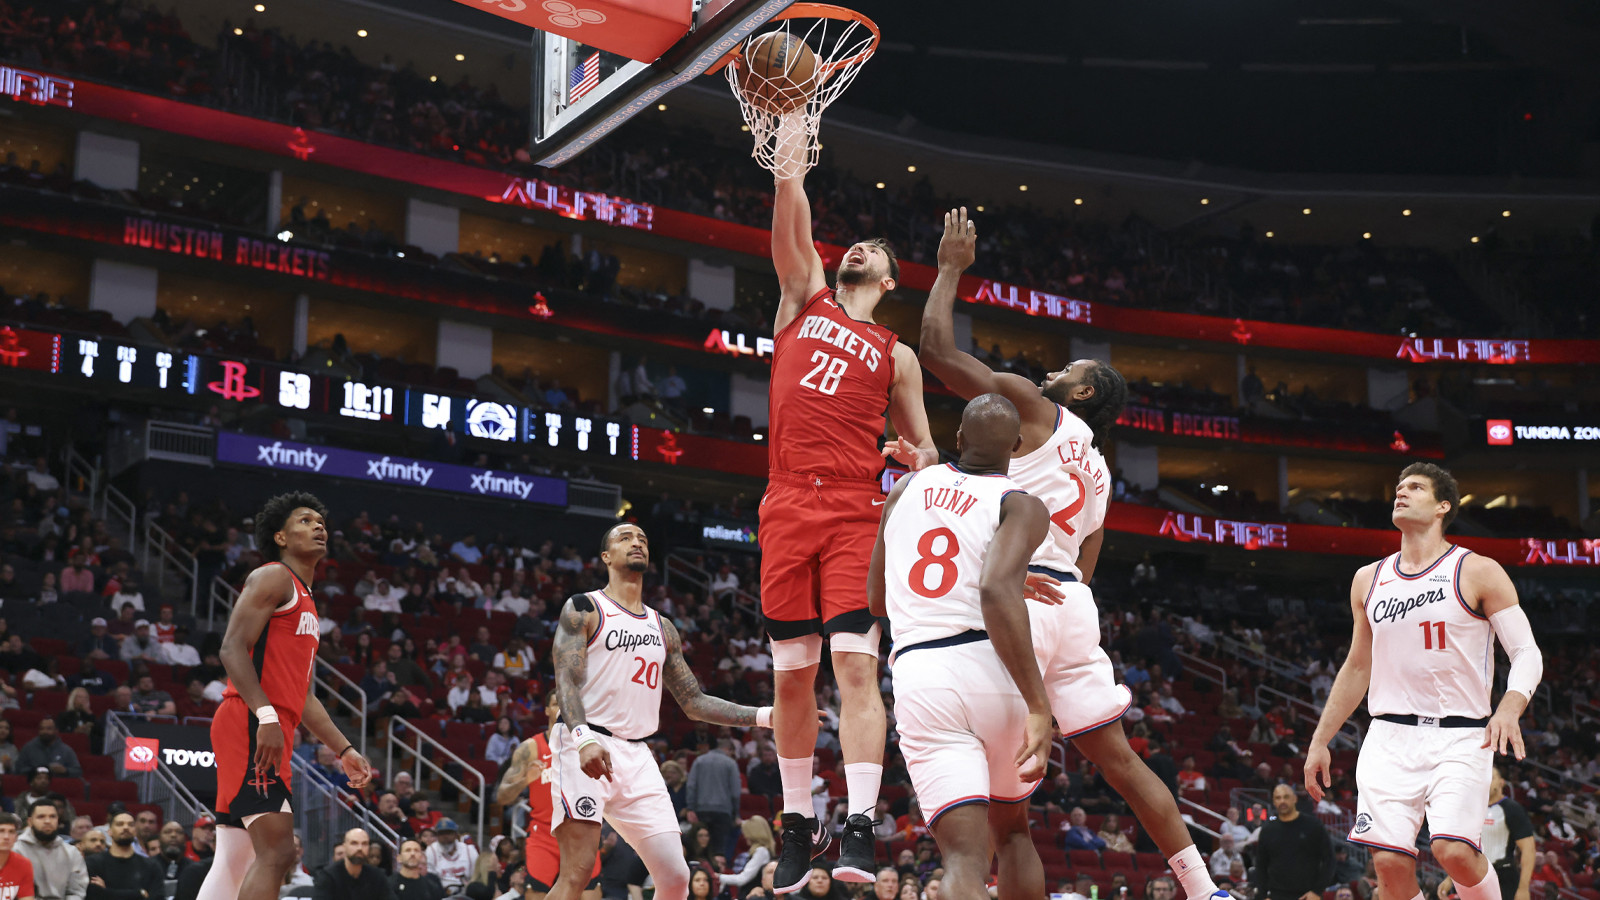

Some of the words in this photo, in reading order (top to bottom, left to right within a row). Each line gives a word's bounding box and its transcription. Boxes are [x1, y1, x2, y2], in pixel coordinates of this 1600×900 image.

[585, 104, 640, 141] veraclinic.net
[643, 86, 662, 103] Hair
[660, 60, 707, 91] Transplant
[702, 36, 737, 64] Turkey
[123, 215, 223, 261] HOUSTON
[236, 236, 330, 281] ROCKETS
[797, 315, 882, 373] ROCKETS
[159, 366, 168, 388] 1
[278, 370, 311, 410] 53
[799, 350, 849, 396] 28
[421, 393, 451, 430] 54
[1173, 411, 1240, 440] ROCKETS
[609, 435, 617, 455] 1
[1514, 426, 1571, 440] TUNDRA
[257, 442, 328, 472] xfinity
[367, 456, 434, 486] xfinity
[470, 470, 534, 500] xfinity
[924, 487, 978, 517] DUNN
[1049, 472, 1086, 537] 2
[703, 524, 743, 542] reliant
[908, 527, 960, 599] 8
[1373, 587, 1446, 624] Clippers
[605, 629, 662, 653] Clippers
[1418, 620, 1446, 650] 11
[306, 647, 315, 682] 1
[631, 656, 659, 690] 20
[162, 748, 218, 768] TOYO
